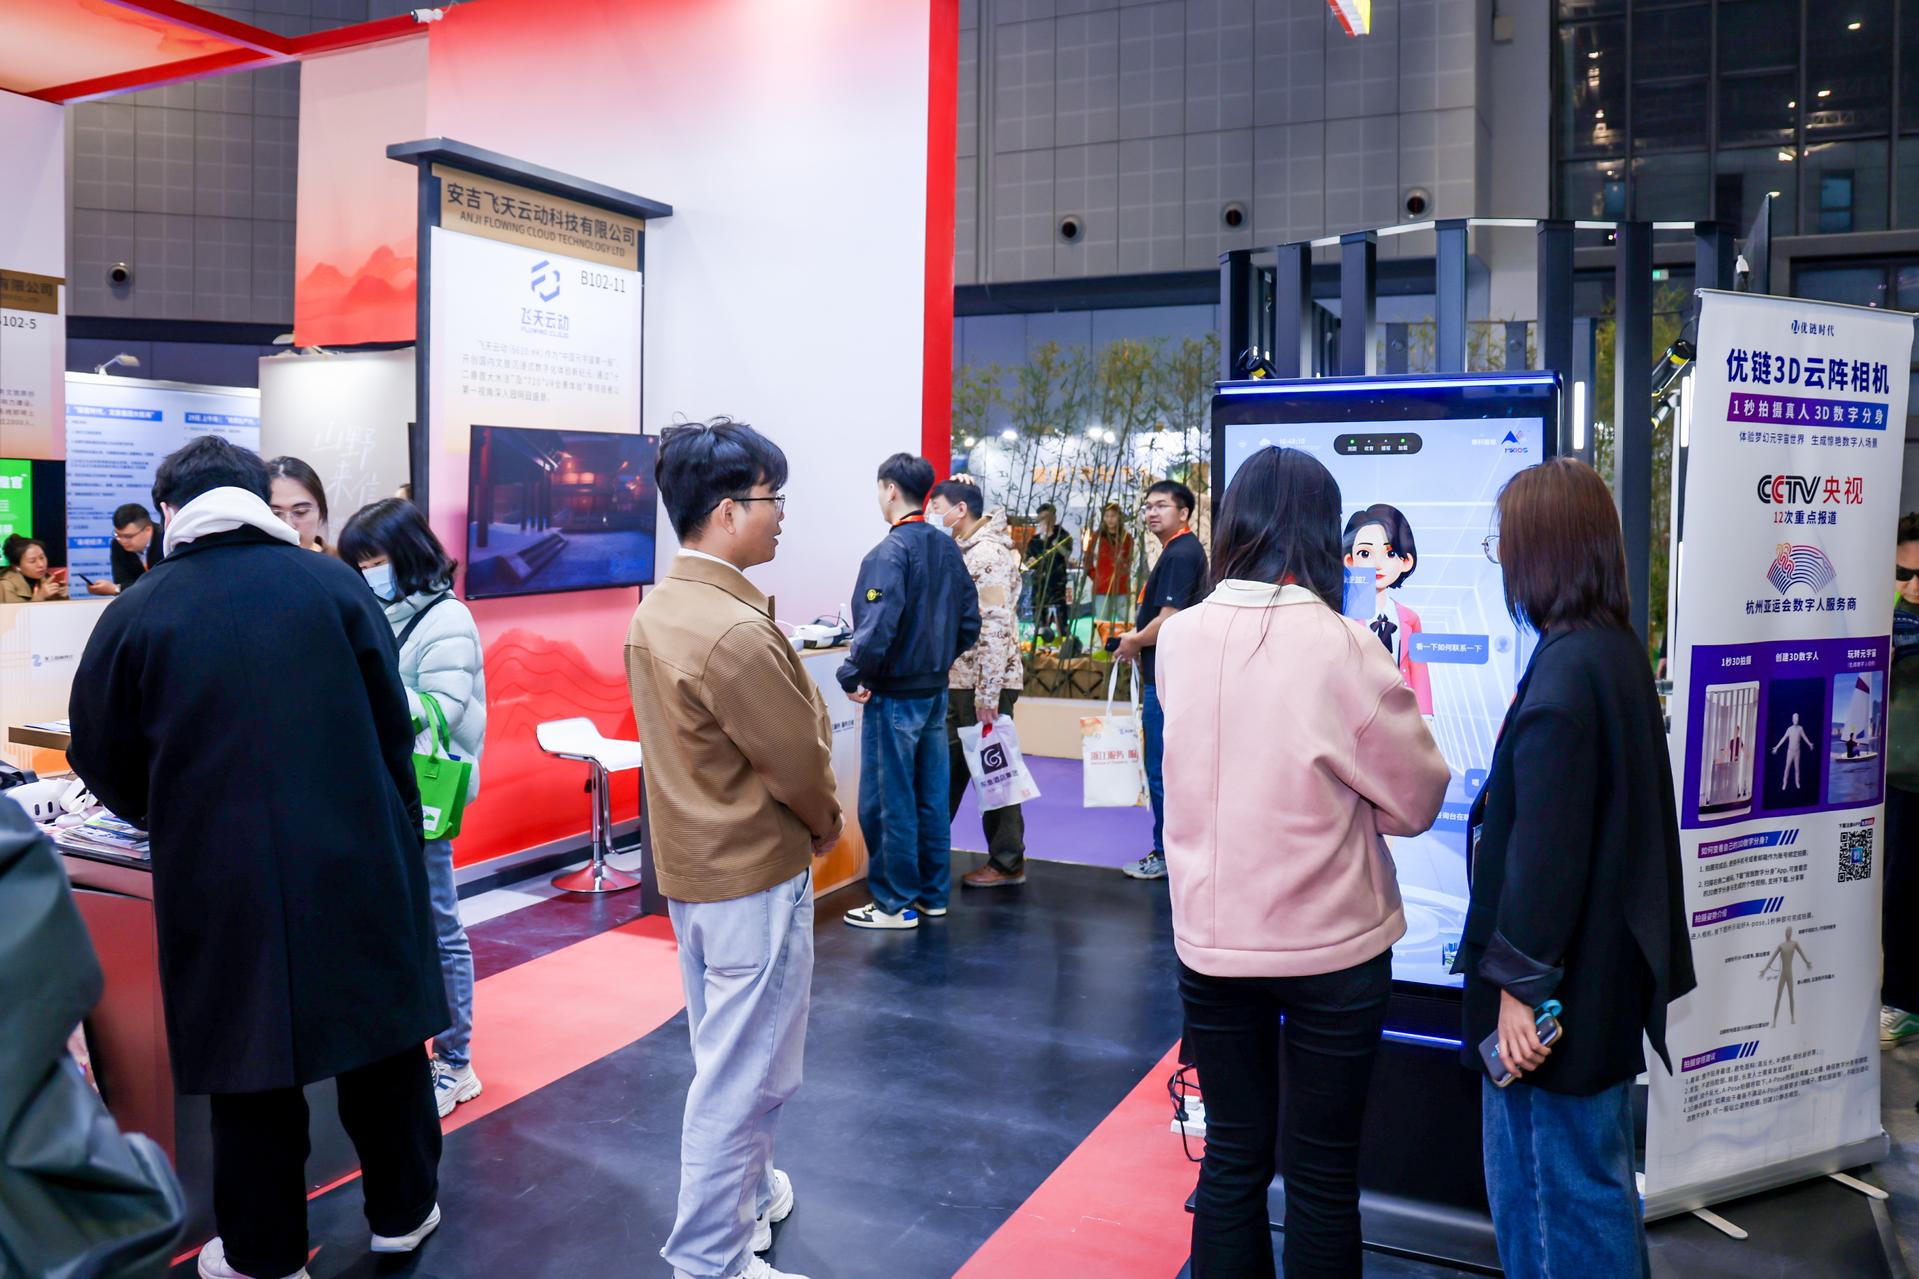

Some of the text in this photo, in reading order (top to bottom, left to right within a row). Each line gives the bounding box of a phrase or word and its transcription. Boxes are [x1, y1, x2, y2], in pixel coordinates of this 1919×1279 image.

[447, 183, 636, 247] 安吉飞天云动科技有限公司
[460, 211, 626, 257] ANJI FLOWING CLOUD TECHNOLOGY LTD
[580, 270, 626, 294] B102-11
[0, 316, 37, 330] 102-5
[520, 307, 569, 331] 飞天云动
[1800, 321, 1835, 337] 优链时代
[1726, 348, 1890, 395] 优链3D云阵相机
[1732, 399, 1884, 425] 1秒拍摄真人3D数字分身
[1739, 431, 1878, 449] 体验梦幻元宇宙世界 生成惊艳数字人场景
[1757, 474, 1864, 505] CCTV 央视
[1774, 510, 1837, 525] 12次重点报道
[1745, 597, 1857, 615] 杭州亚运会数字人服务商
[1775, 651, 1819, 663] 创建3D数字人
[1847, 648, 1877, 659] 玩转元宇宙
